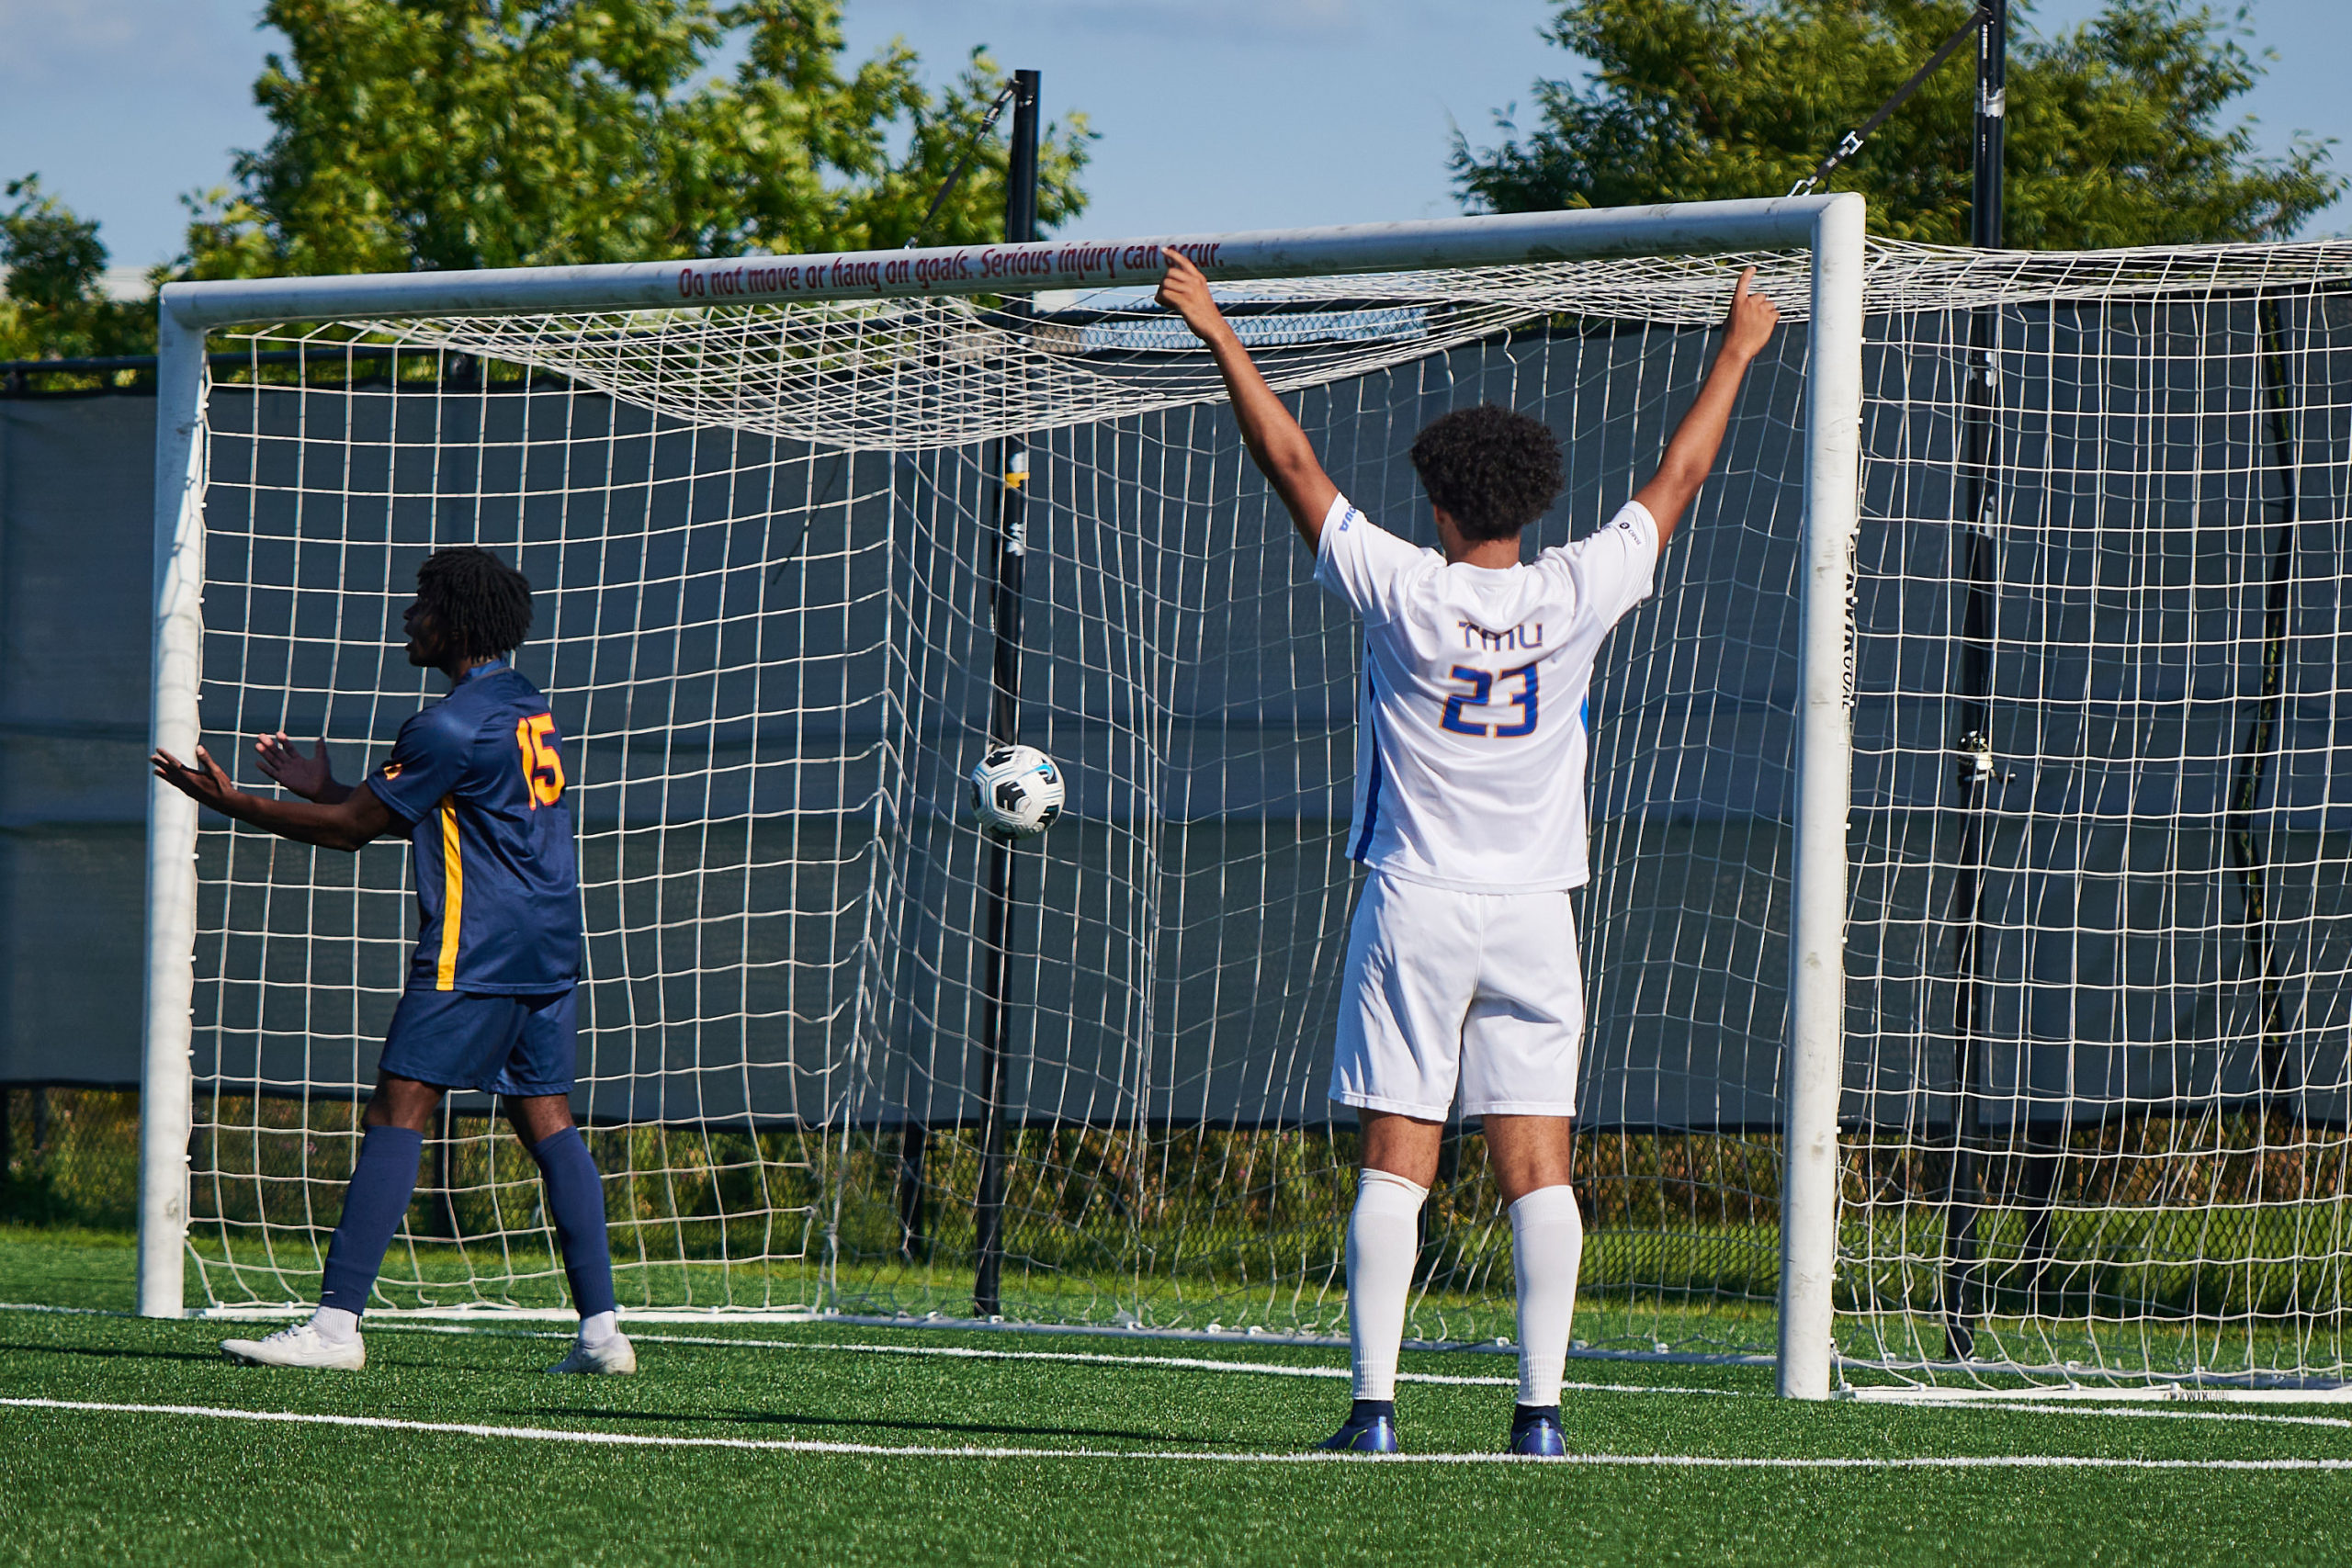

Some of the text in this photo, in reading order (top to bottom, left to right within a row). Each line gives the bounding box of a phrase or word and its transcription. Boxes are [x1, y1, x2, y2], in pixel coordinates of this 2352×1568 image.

[680, 267, 706, 298] Do
[710, 266, 745, 296] not
[748, 266, 801, 294] move
[806, 264, 828, 289] or
[831, 256, 882, 292] hang
[885, 259, 910, 285] on
[915, 249, 974, 289] goals.
[980, 245, 1054, 278] Serious
[1058, 242, 1120, 280] injury
[1123, 244, 1160, 270] can
[1456, 620, 1543, 652] TMU
[1439, 662, 1540, 739] 23
[515, 712, 566, 811] 15
[2179, 1390, 2230, 1402] KWIKGO
